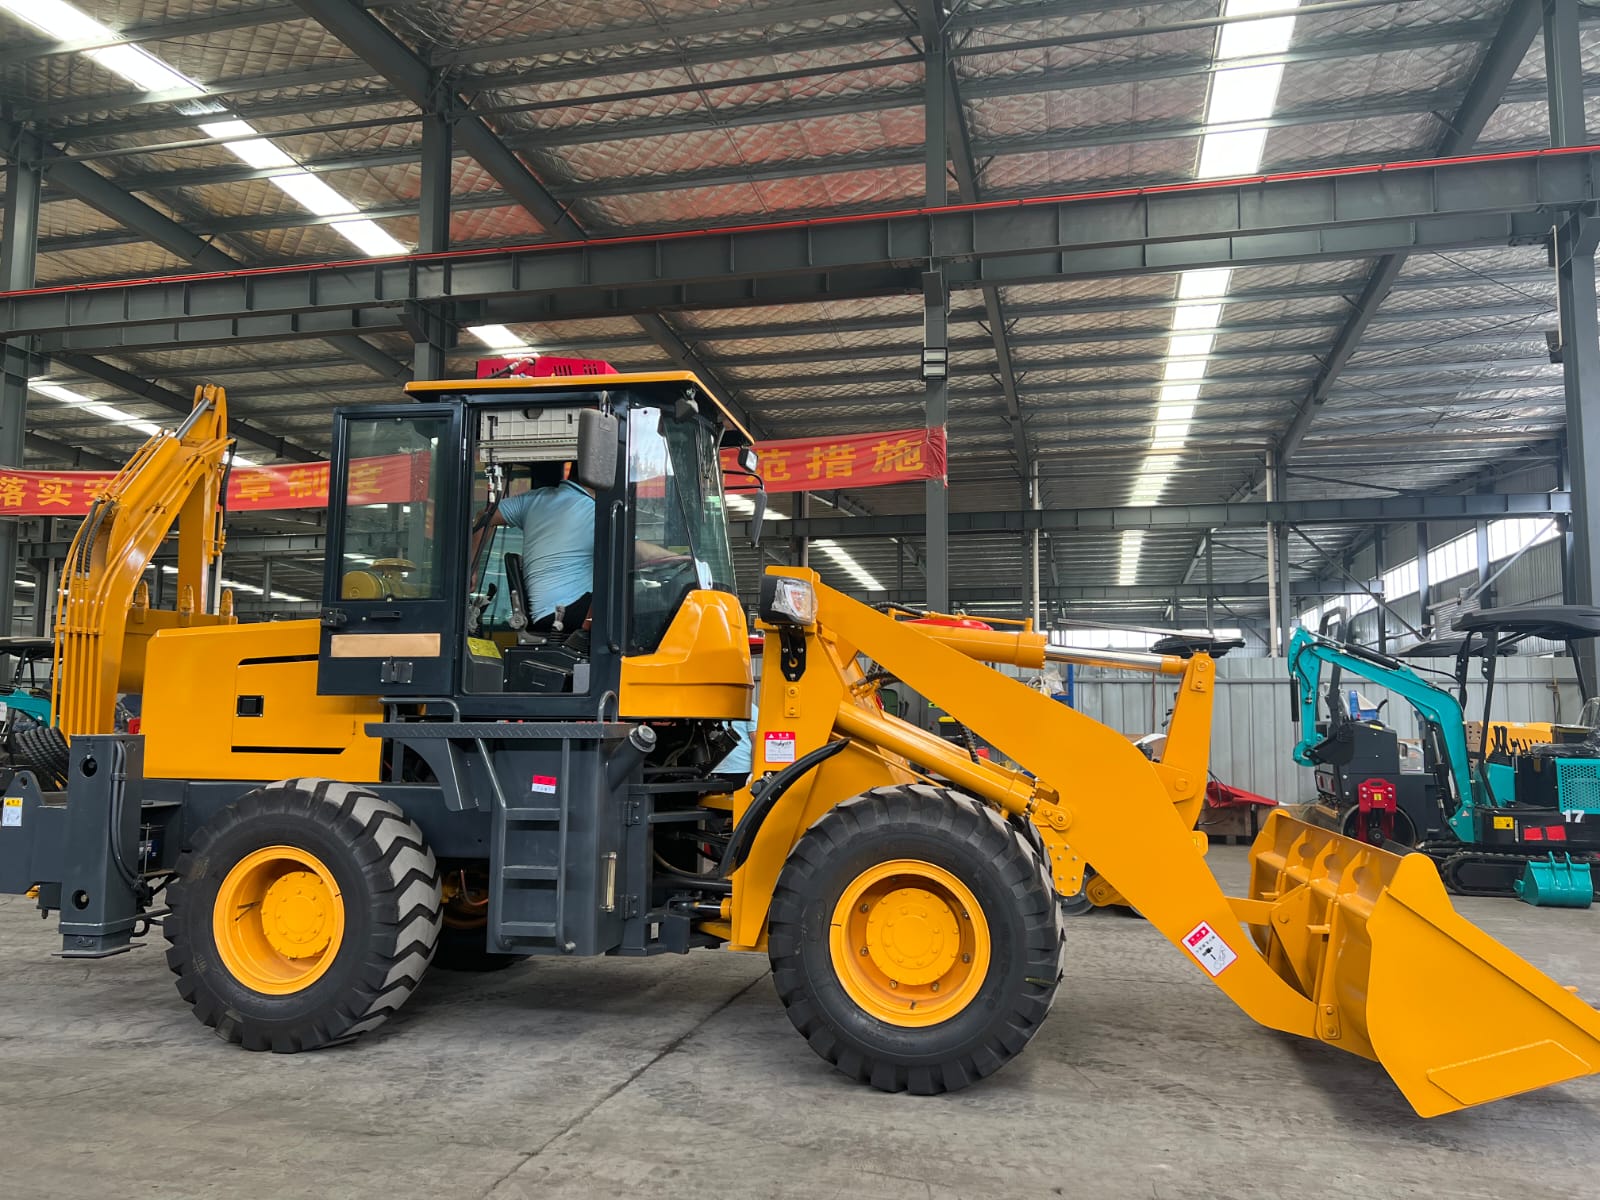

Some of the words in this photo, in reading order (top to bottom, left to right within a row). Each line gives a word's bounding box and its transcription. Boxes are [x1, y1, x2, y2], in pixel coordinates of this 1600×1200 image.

[719, 439, 923, 483] 范措施
[1562, 809, 1585, 823] 17
